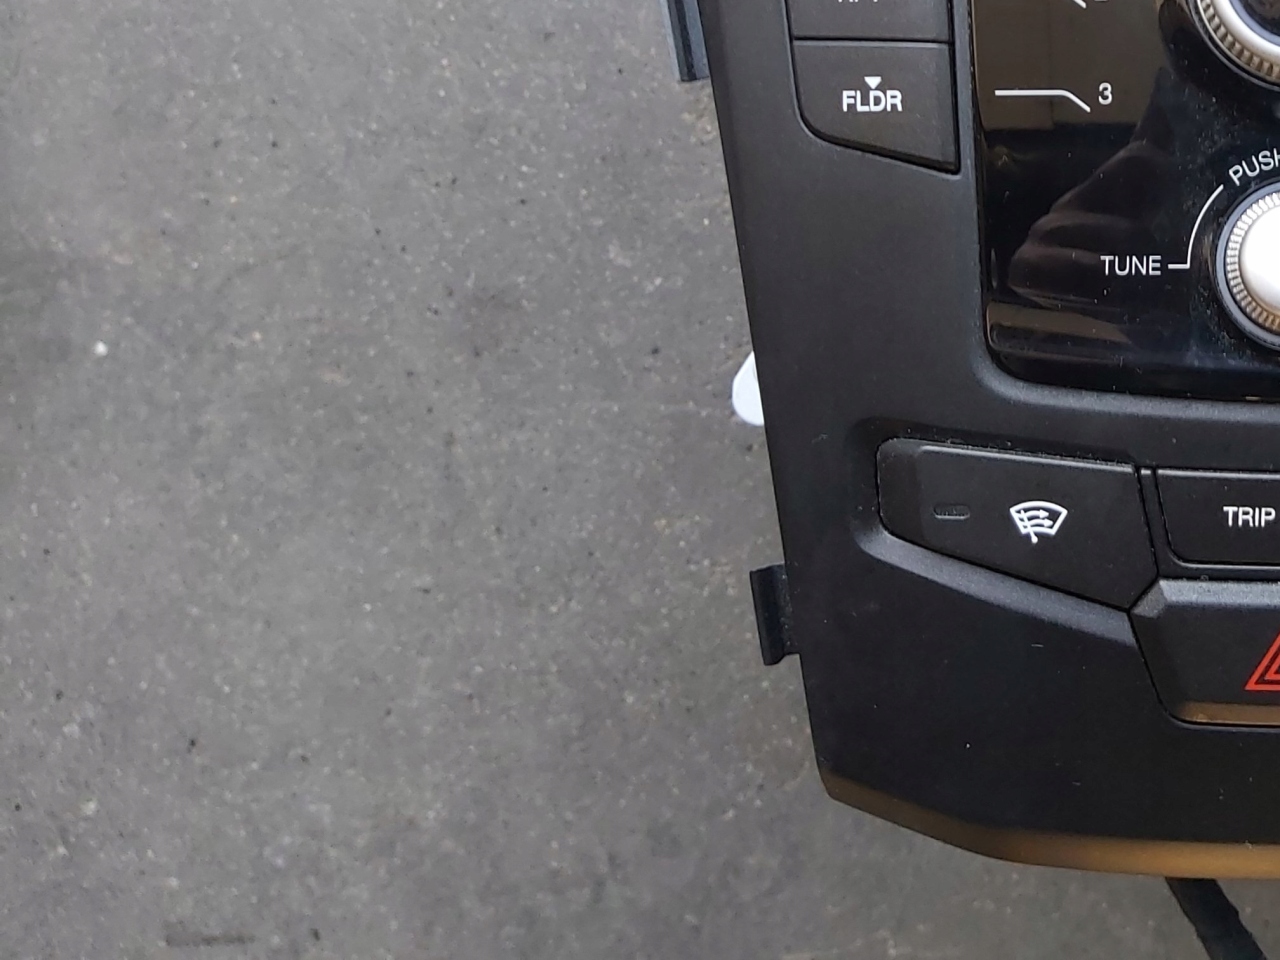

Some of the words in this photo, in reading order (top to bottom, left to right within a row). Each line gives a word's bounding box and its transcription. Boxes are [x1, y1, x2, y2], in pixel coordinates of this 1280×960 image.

[842, 88, 903, 112] FLDR
[1098, 82, 1113, 105] 3
[1100, 255, 1162, 276] TUNE
[1222, 506, 1276, 528] TRIP
